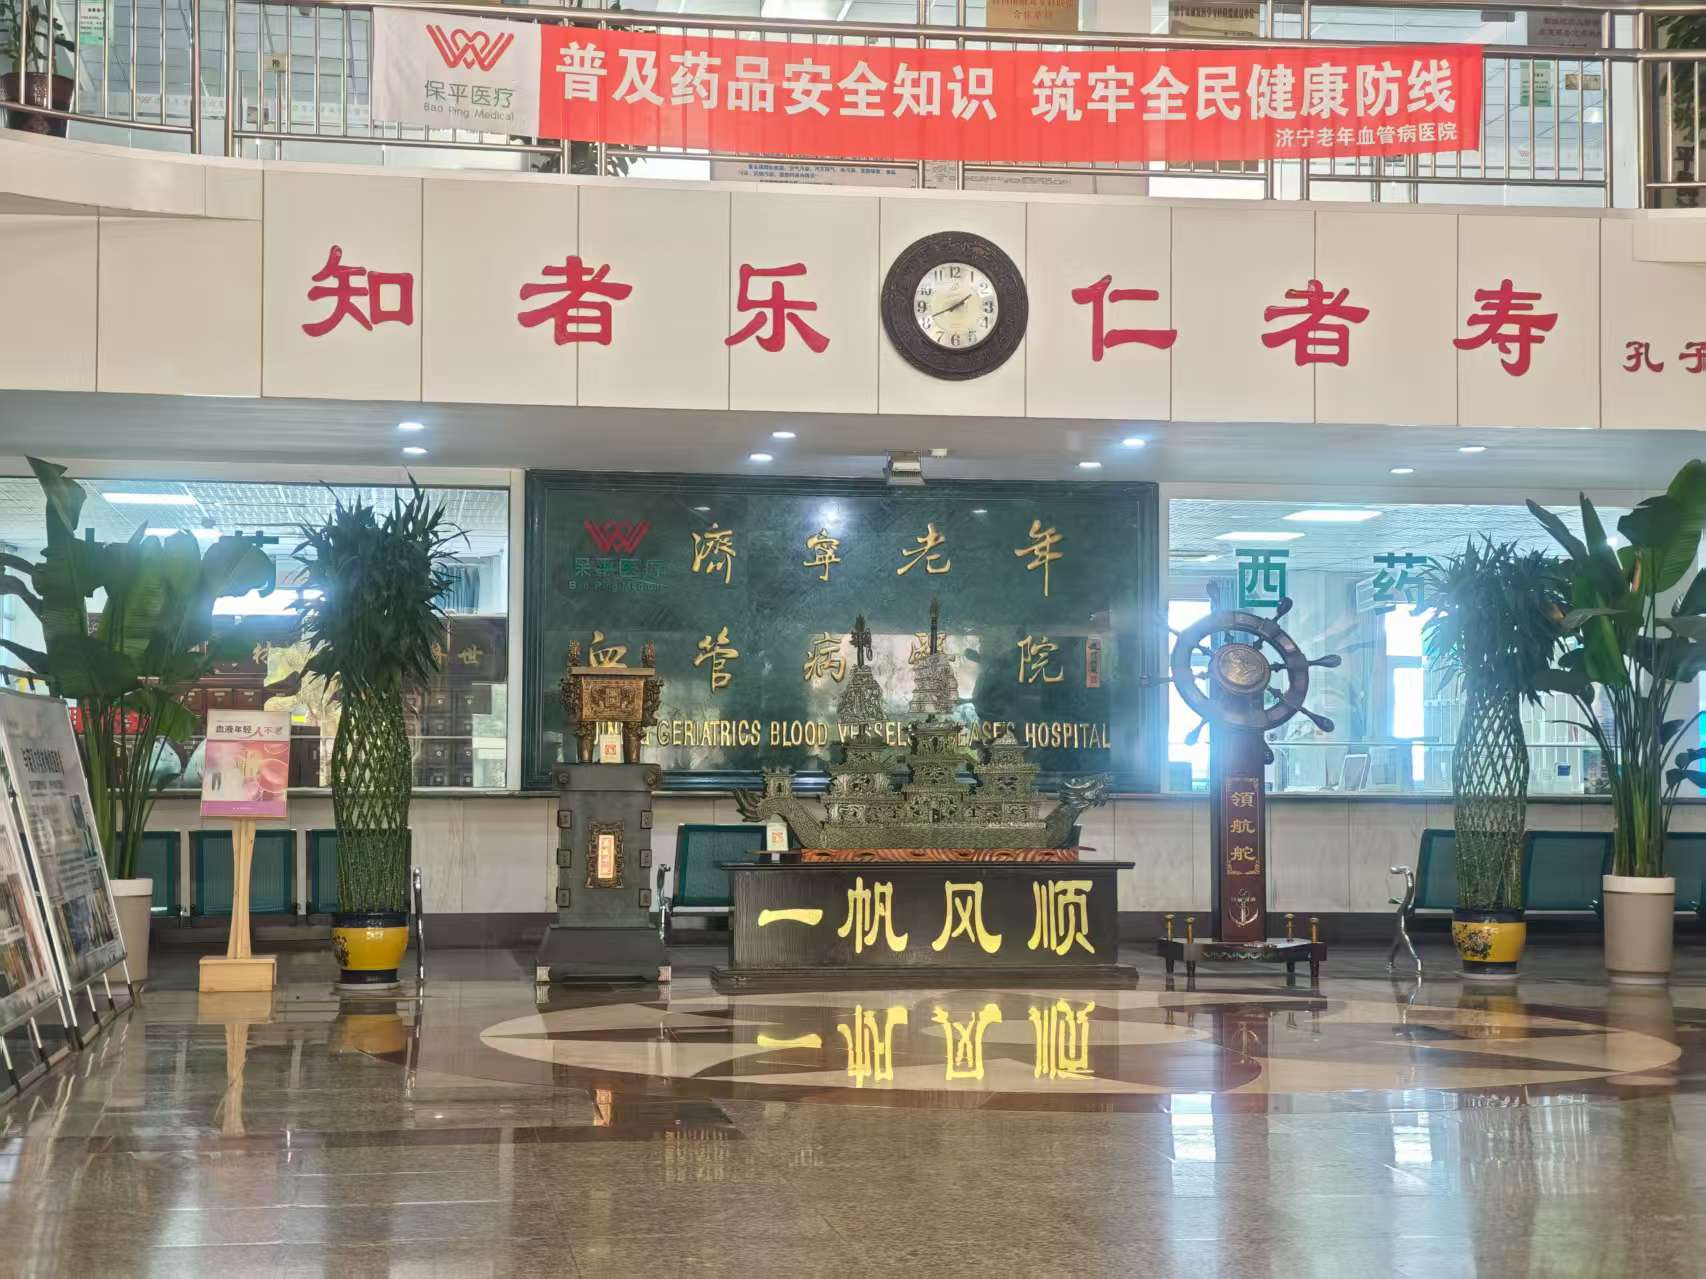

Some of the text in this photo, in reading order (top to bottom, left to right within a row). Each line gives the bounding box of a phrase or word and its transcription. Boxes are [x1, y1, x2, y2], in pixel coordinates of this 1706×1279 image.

[556, 40, 997, 121] 普及药品安全知识
[1031, 58, 1456, 124] 筑牢全民健康防线
[425, 79, 514, 109] 保平医疗
[424, 103, 514, 121] Bao Ping Medical
[1275, 121, 1458, 149] 济宁老年血管病医院
[934, 269, 943, 281] 11
[950, 266, 961, 279] 12
[302, 244, 831, 353] 知者乐
[1072, 274, 1558, 377] 仁者寿
[917, 301, 927, 313] 9
[984, 301, 994, 314] 3
[935, 330, 945, 343] 7
[950, 334, 961, 346] 6
[656, 718, 762, 747] GERIATRICS
[769, 718, 829, 748] BLOOD
[1025, 720, 1112, 749] HOSPITAL
[757, 875, 1096, 956] 一帆风顺
